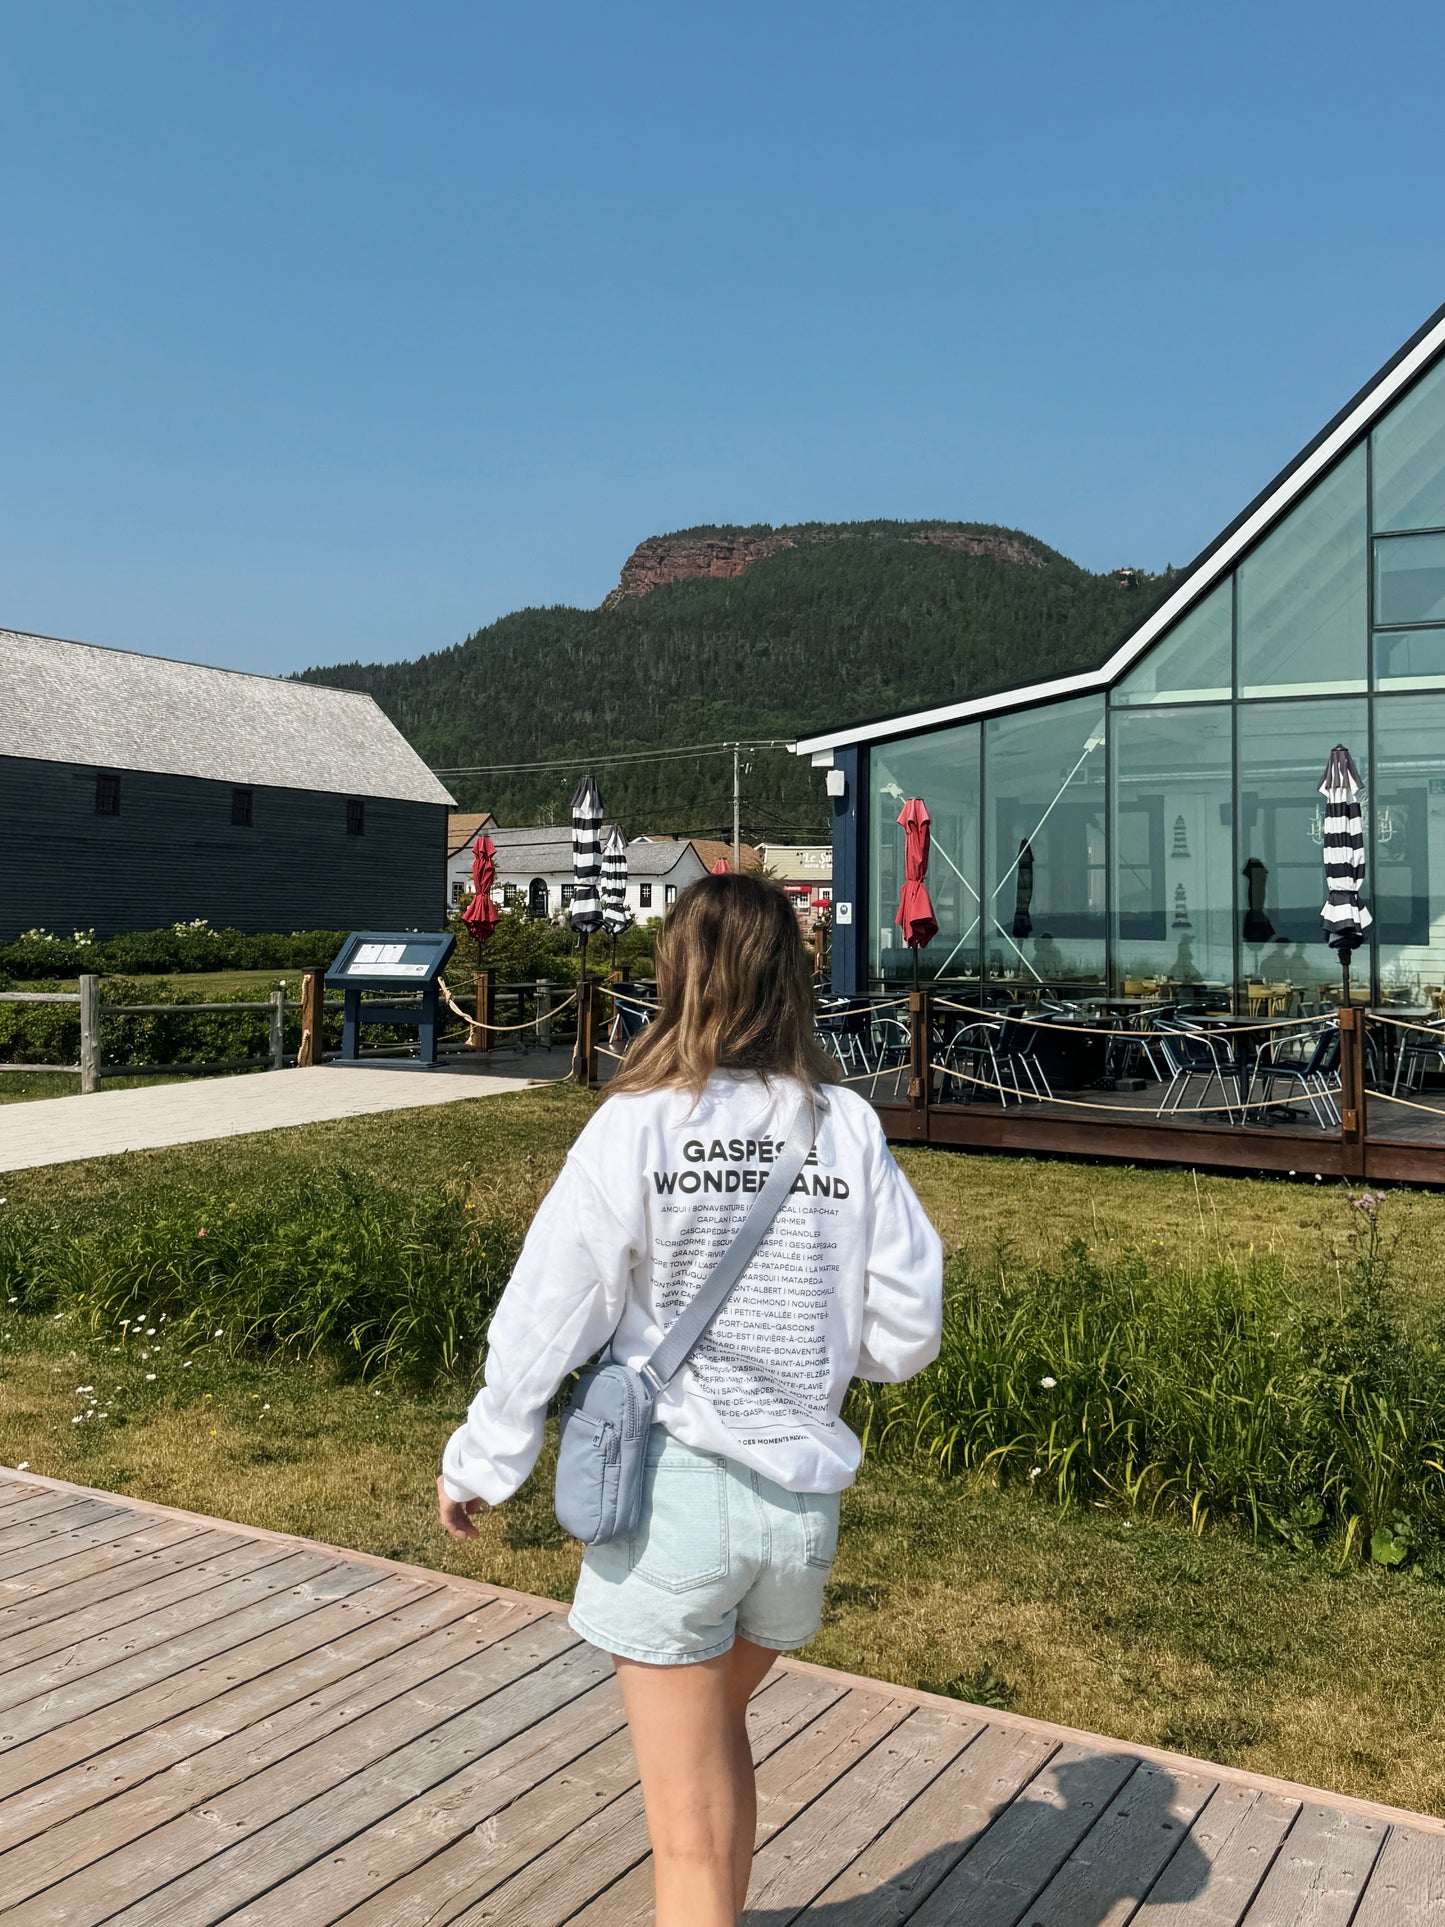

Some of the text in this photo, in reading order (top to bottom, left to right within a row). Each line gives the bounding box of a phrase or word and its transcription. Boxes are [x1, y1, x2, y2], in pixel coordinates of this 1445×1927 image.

[683, 1135, 818, 1166] GASPÉE
[653, 1170, 850, 1200] WONDERAND
[692, 1204, 745, 1212] BONAVENTURE
[655, 1238, 706, 1247] CLORIDORME
[670, 1260, 693, 1268] TOWN
[734, 1284, 782, 1294] ONT-ALBERT
[743, 1297, 786, 1306] RICHMOND
[735, 1308, 792, 1319] PETITE-VALLÉE
[757, 1436, 790, 1444] MOMENTS
